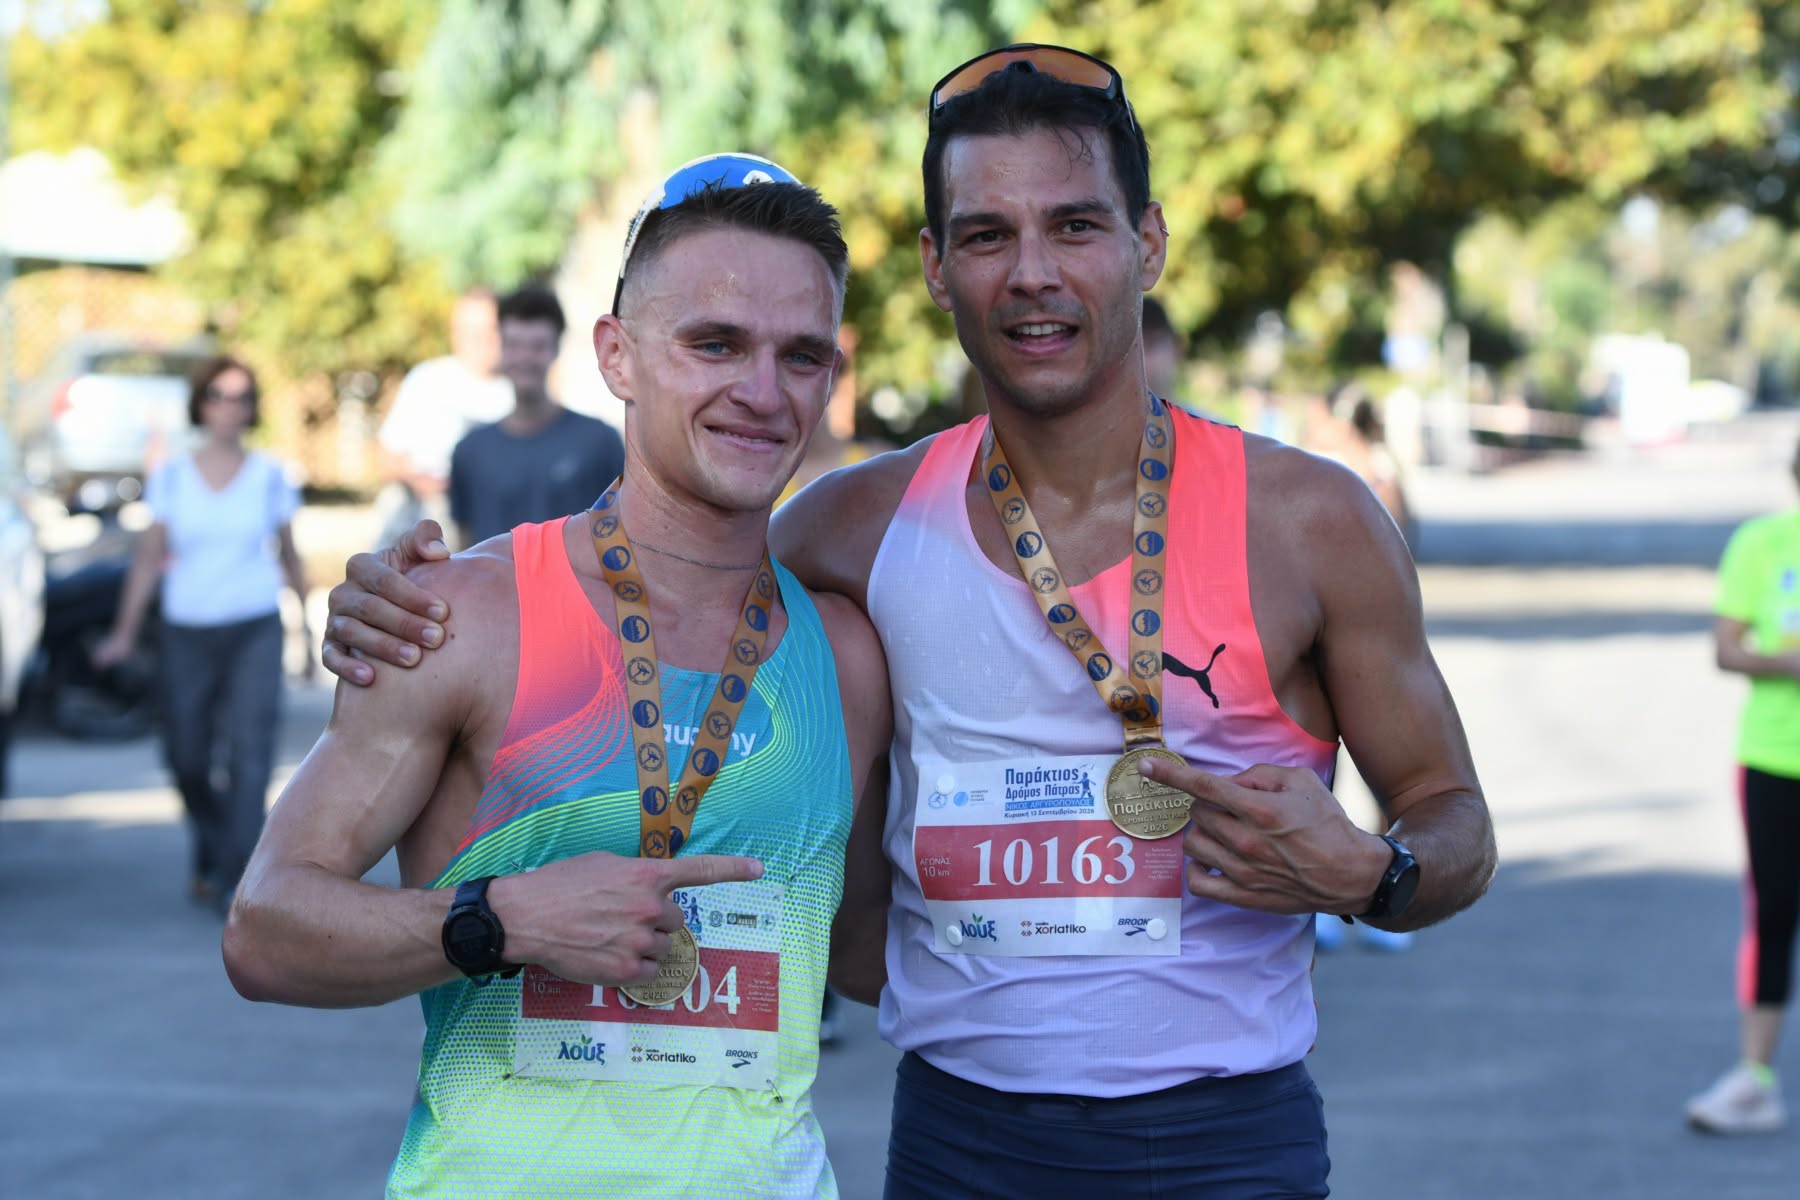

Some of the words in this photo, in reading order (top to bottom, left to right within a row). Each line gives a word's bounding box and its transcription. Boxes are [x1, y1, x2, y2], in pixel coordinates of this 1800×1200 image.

[1005, 765, 1079, 787] Παράκτιος
[1006, 787, 1041, 800] Δρόμος
[1044, 784, 1080, 797] Πάτρας
[1114, 797, 1191, 816] Παράκτιος
[1143, 823, 1168, 833] 2026
[919, 857, 951, 866] ΑΓΩΝΑΣ
[973, 836, 1135, 886] 10163
[923, 866, 936, 877] 10
[937, 868, 950, 877] km
[1035, 920, 1087, 935] xoriatiko
[1117, 918, 1150, 926] BROOK
[643, 991, 667, 1000] 2026
[646, 1050, 697, 1064] xoriatiko
[725, 1049, 758, 1059] BROOKS
